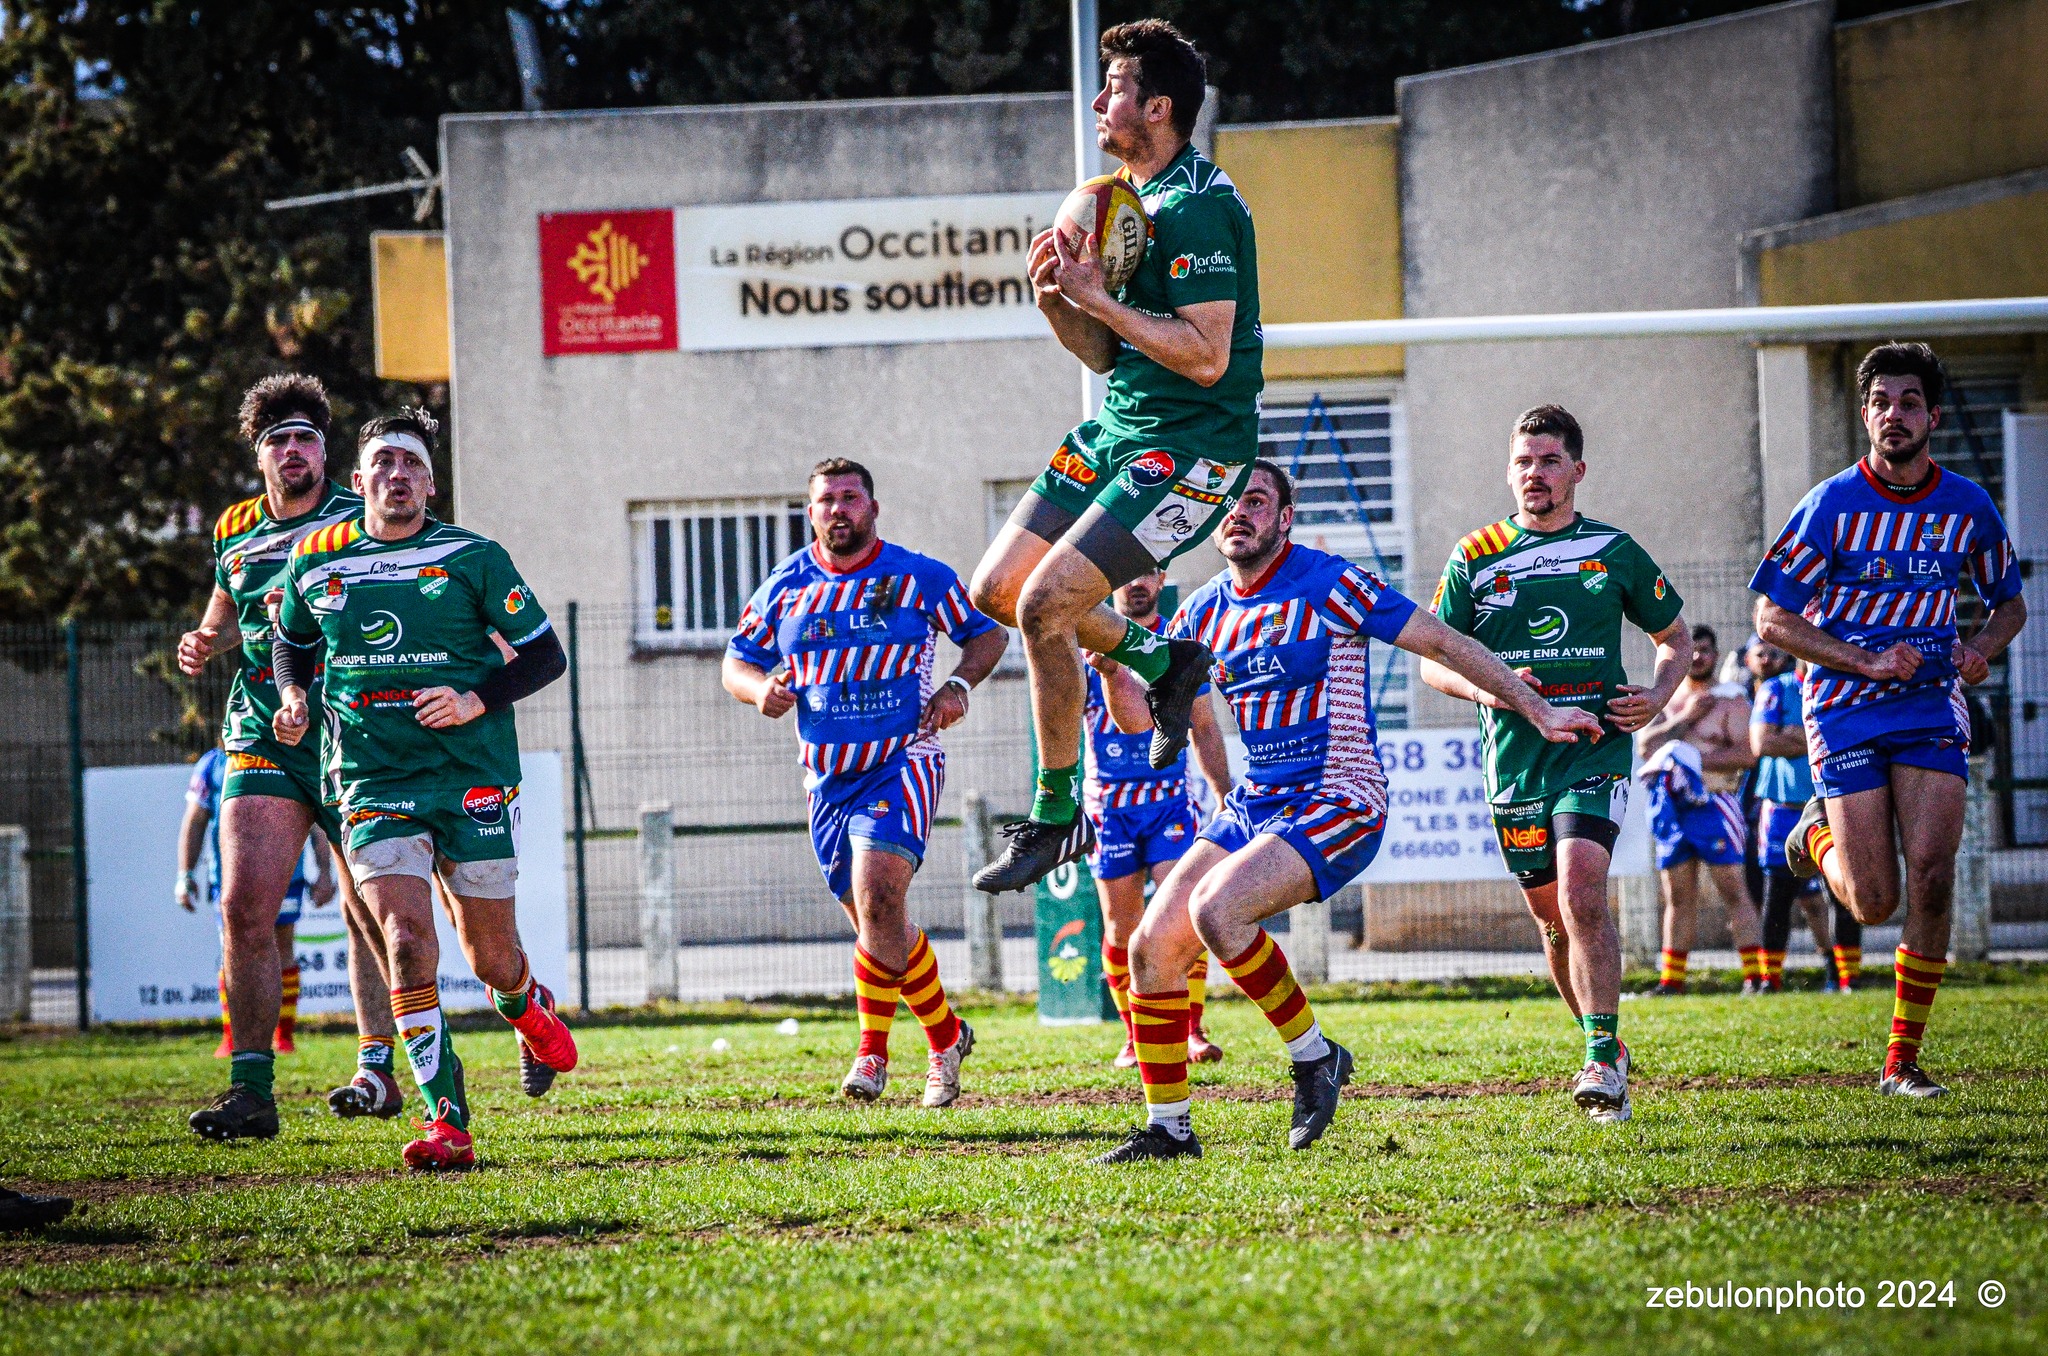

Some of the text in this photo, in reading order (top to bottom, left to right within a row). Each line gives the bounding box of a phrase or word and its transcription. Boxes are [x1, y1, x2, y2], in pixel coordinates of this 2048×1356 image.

[709, 214, 1050, 269] La Région Occitani
[1193, 250, 1232, 269] Jardins
[740, 279, 850, 317] Nous
[1115, 476, 1140, 499] THUIR
[1908, 556, 1942, 577] LEA
[849, 614, 888, 630] LEA
[329, 652, 449, 666] GROUPE ENR A'VENIR
[1533, 648, 1559, 659] ENR
[1562, 647, 1605, 657] A'VENIR
[1247, 654, 1286, 674] LEA
[831, 698, 901, 714] GONZALEZ
[1250, 736, 1309, 754] GROUPE
[1380, 741, 1424, 771] 68
[1823, 754, 1847, 765] Artisan
[260, 768, 286, 776] ASPRES
[465, 793, 501, 808] SPORT
[478, 825, 505, 837] THUIR
[1501, 824, 1547, 849] Netto
